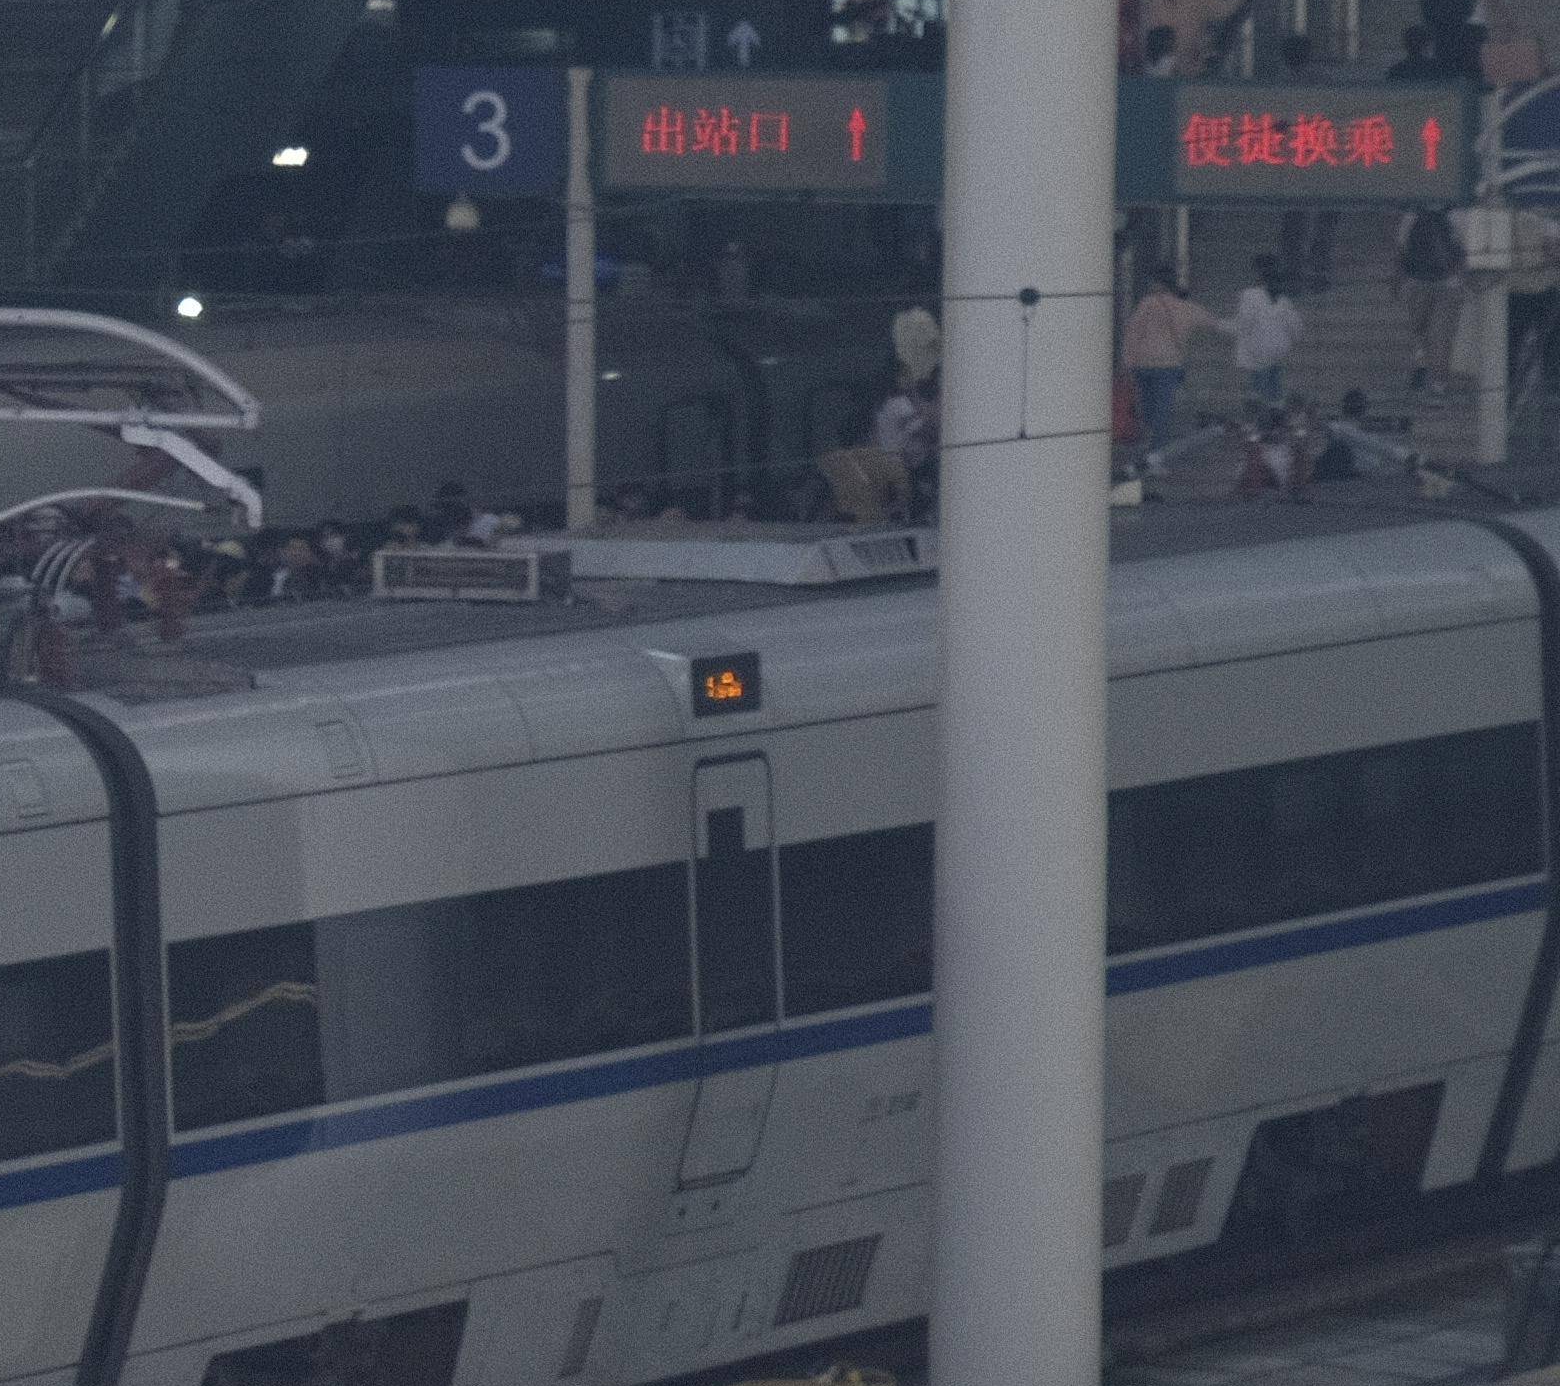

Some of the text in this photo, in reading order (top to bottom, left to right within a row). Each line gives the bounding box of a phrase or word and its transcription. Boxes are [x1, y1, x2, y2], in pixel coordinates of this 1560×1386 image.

[460, 90, 511, 172] 3
[640, 108, 792, 158] 出站口
[1182, 112, 1394, 168] 便捷换乘
